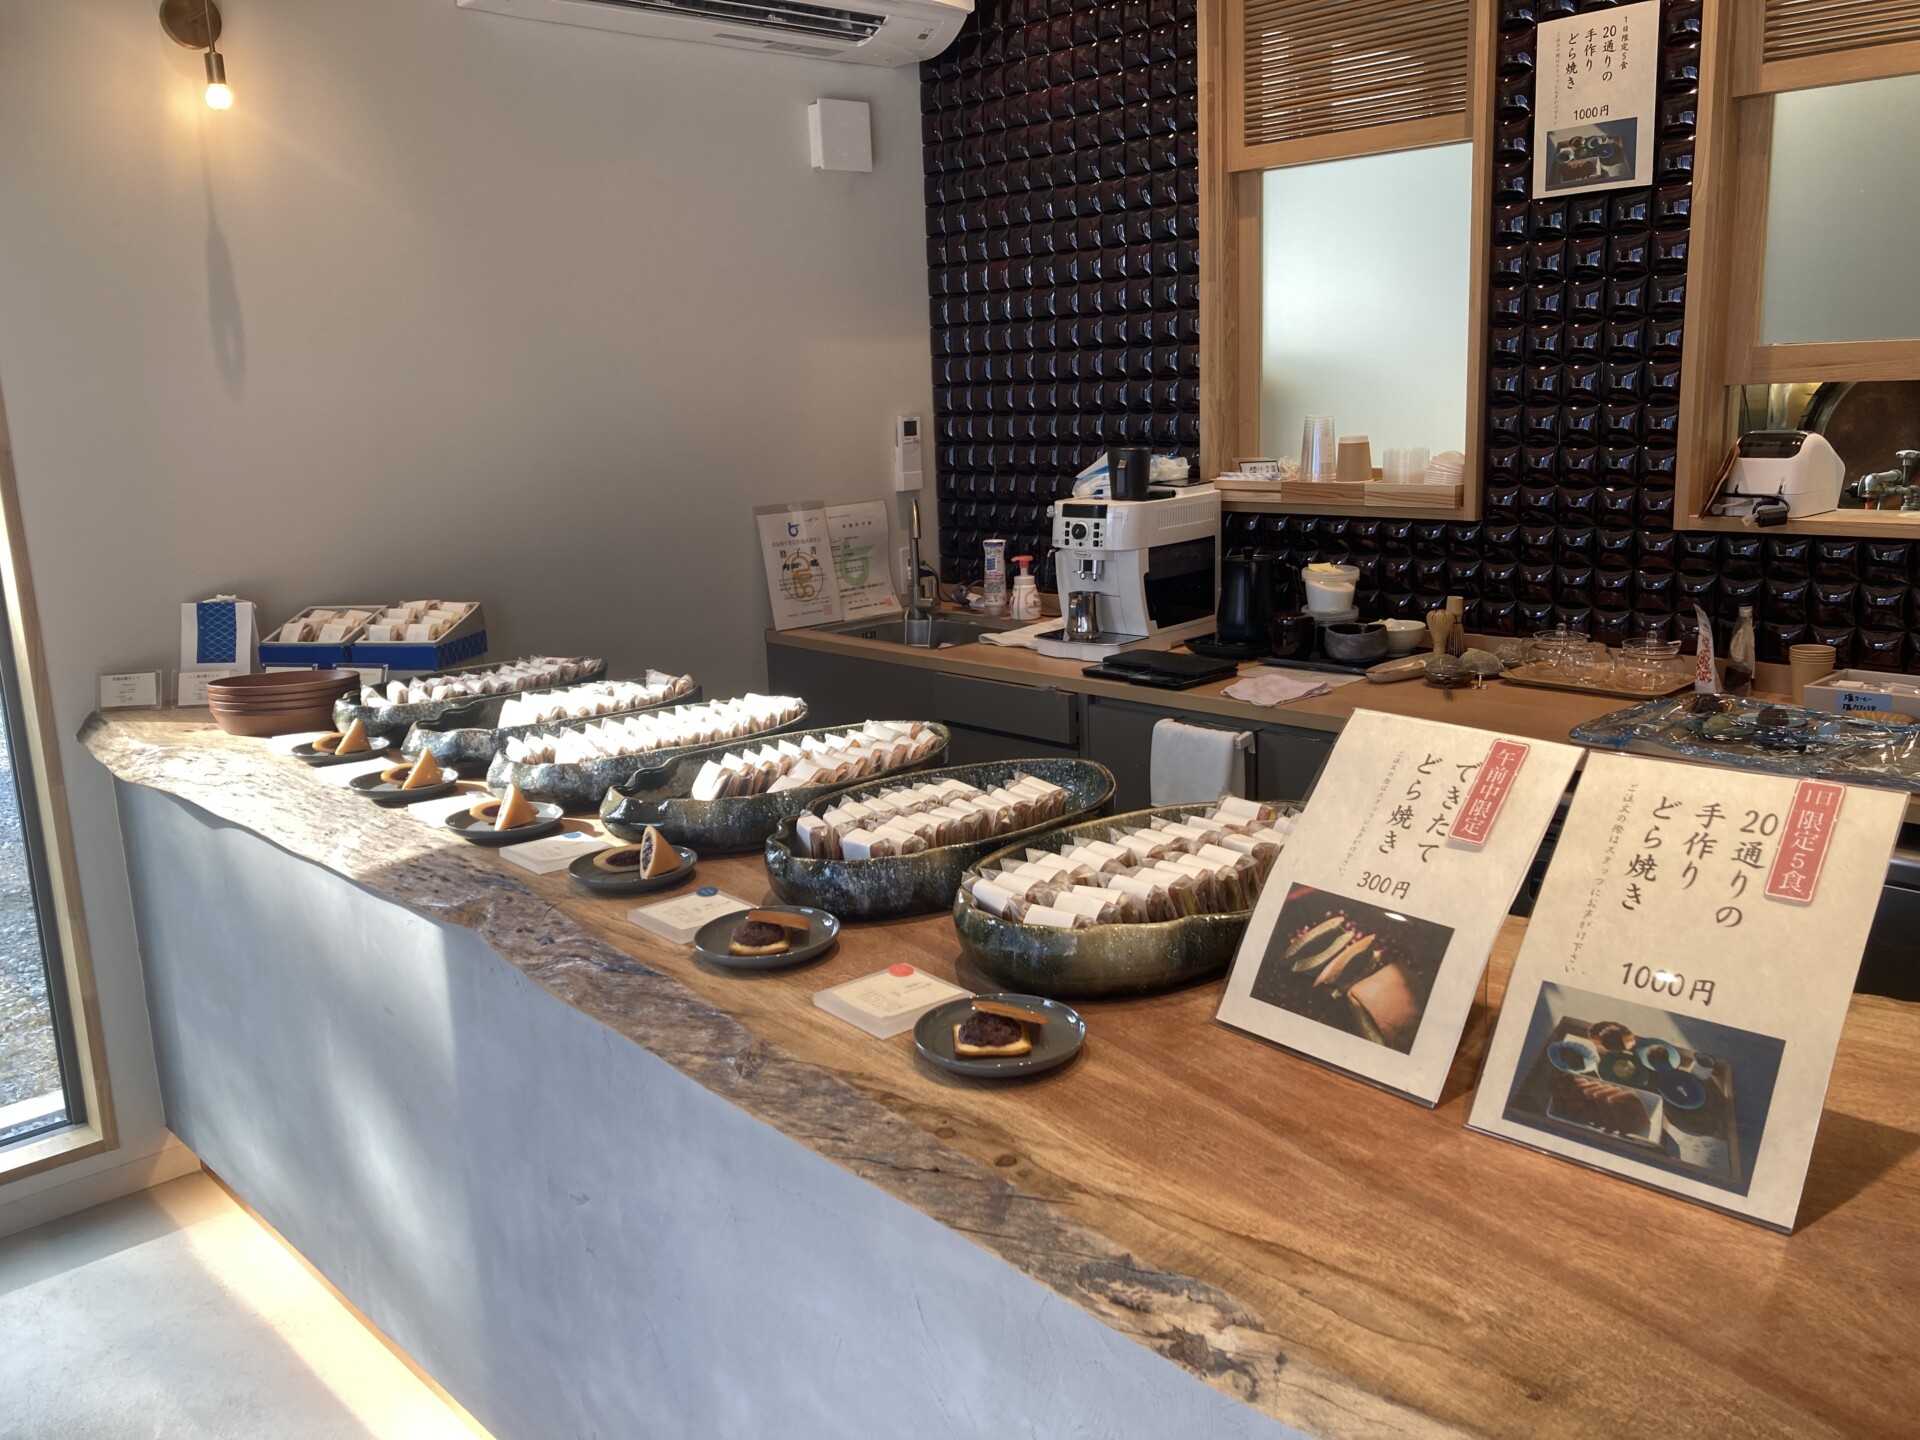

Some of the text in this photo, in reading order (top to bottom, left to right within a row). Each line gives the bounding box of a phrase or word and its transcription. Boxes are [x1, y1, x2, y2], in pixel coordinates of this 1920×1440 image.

[1565, 33, 1579, 89] どら焼き
[1584, 28, 1597, 72] 手作り
[1602, 25, 1617, 82] 20通りの
[1620, 16, 1629, 70] 1日限定5食
[1574, 104, 1609, 121] 1000円
[1379, 753, 1444, 854] どら焼き
[1418, 761, 1483, 863] できたて
[1461, 748, 1516, 836] 午前中限定
[1621, 796, 1682, 911] どら焼き
[1681, 803, 1727, 890] 手作り
[1715, 810, 1779, 928] 20通りの
[1778, 788, 1834, 893] 1日限定5食
[1356, 871, 1411, 900] 300円
[1621, 962, 1716, 1007] 1000円
